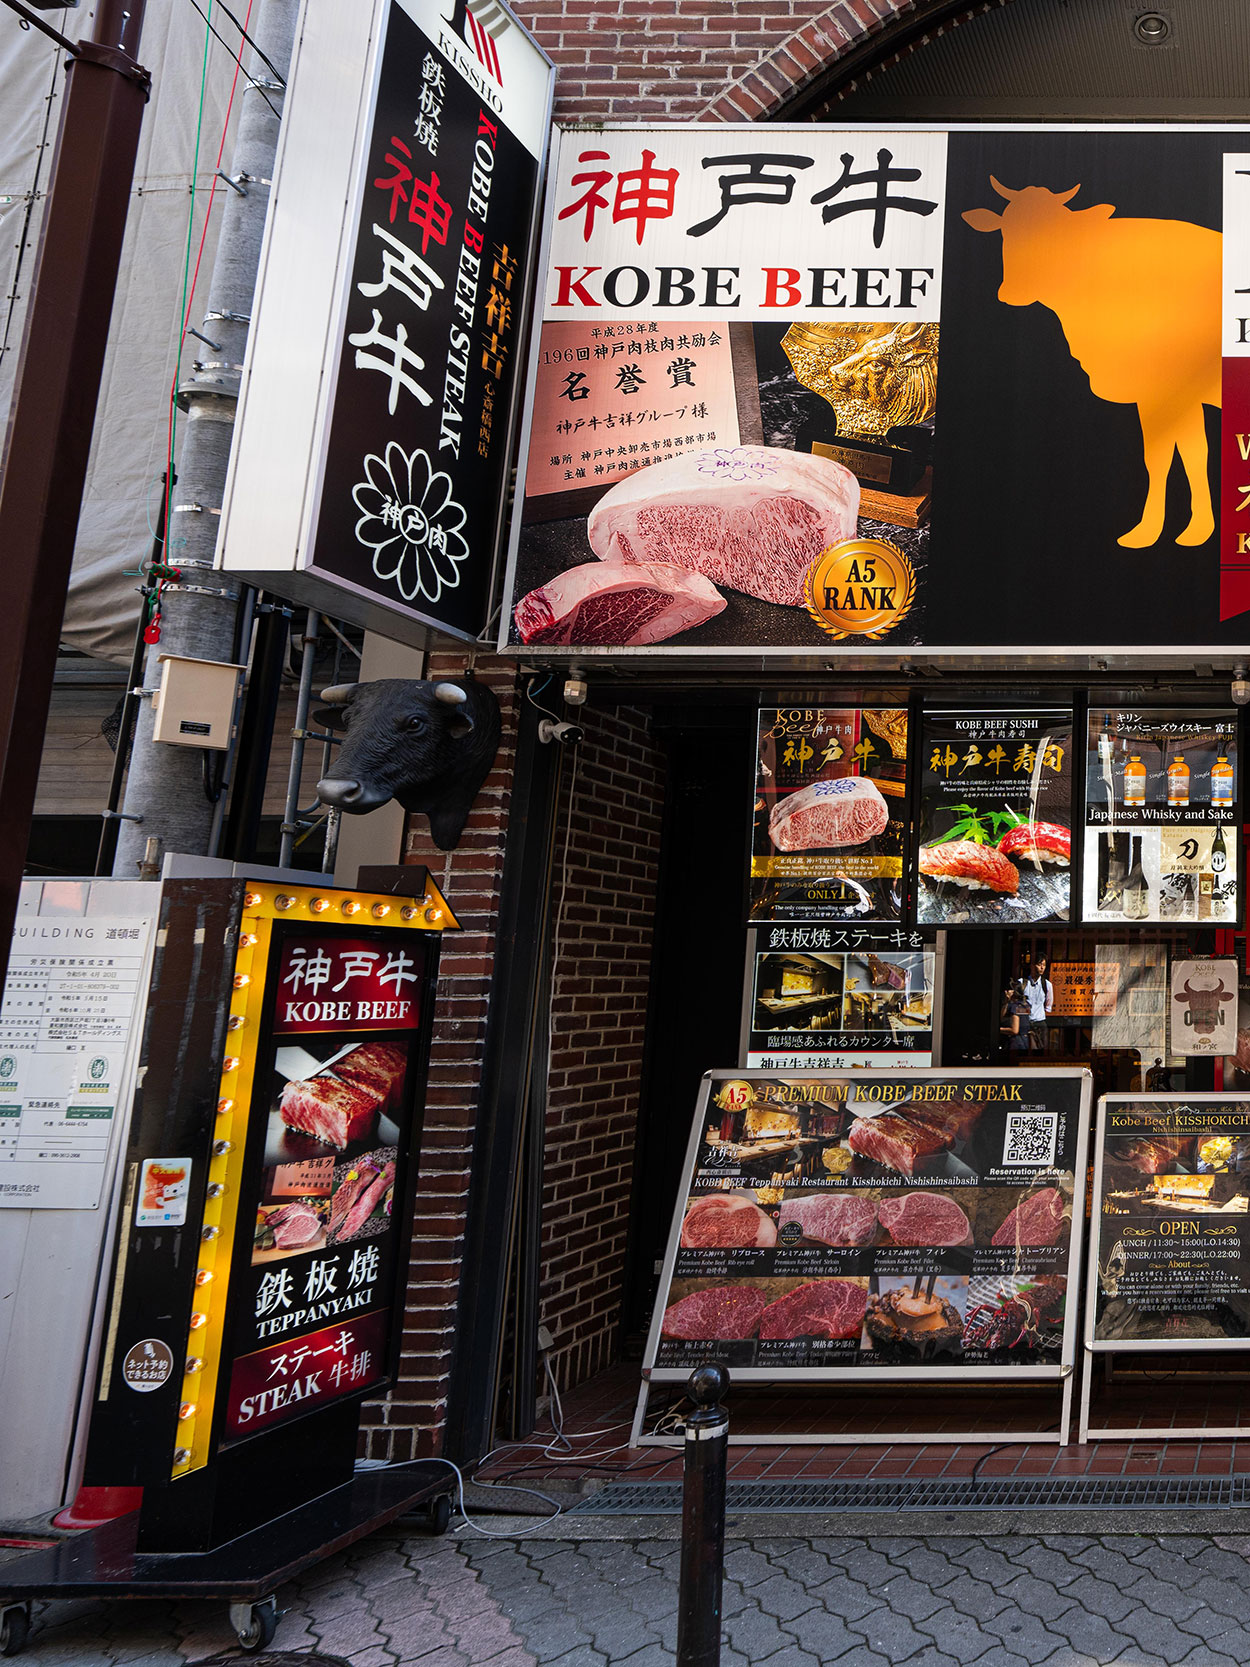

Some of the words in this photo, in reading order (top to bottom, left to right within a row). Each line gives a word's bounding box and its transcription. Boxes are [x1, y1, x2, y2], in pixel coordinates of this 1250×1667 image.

[437, 29, 504, 113] KISSHO
[413, 52, 446, 157] 鉄板焼
[467, 109, 499, 223] KOBE
[558, 149, 938, 248] 神戸牛
[348, 135, 454, 415] 神戸牛
[455, 222, 487, 327] BEEF
[551, 266, 741, 308] KOBE
[759, 267, 933, 308] BEEF
[481, 243, 519, 381] 吉祥吉
[591, 322, 659, 338] 平成28年度
[538, 331, 722, 364] 196回神戸肉枝肉共励会
[438, 329, 473, 459] STEAK
[477, 381, 495, 459] 心斎橋西店
[556, 405, 688, 435] 神戸牛吉祥グループ
[692, 402, 709, 418] 様
[550, 454, 572, 466] 場所
[380, 495, 449, 556] 神戸肉
[845, 560, 876, 583] A5
[823, 587, 897, 612] RANK
[777, 709, 824, 722] KOBE
[956, 720, 981, 729] KOBE
[984, 720, 1007, 729] BEEF
[1009, 720, 1038, 729] SUSHI
[1116, 713, 1143, 722] キリン
[763, 717, 826, 739] Beef
[1116, 723, 1212, 733] ジャパニーズウイスキー
[1215, 723, 1235, 733] 富士
[782, 737, 880, 773] 神戸牛
[929, 744, 1064, 778] 神戸牛寿司
[1089, 809, 1139, 821] Japanese
[1141, 809, 1182, 821] Whisky
[1184, 809, 1205, 820] and
[1208, 809, 1234, 820] Sake
[808, 890, 838, 900] ONLY
[769, 928, 923, 948] 鉄板焼ステーキを
[283, 947, 418, 998] 神戸牛
[283, 1002, 351, 1023] KOBE
[355, 1001, 411, 1022] BEEF
[767, 1036, 915, 1048] 臨場感あふれるカウンター席
[725, 1087, 748, 1104] A5
[764, 1085, 849, 1102] PREMIUM
[855, 1085, 906, 1102] KOBE
[911, 1085, 958, 1102] BEEF
[963, 1085, 1023, 1101] STEAK
[1112, 1116, 1141, 1126] Kobe
[1144, 1116, 1171, 1126] Beef
[749, 1177, 799, 1188] Teppanyaki
[801, 1176, 849, 1187] Restaurant
[852, 1176, 901, 1186] Kisshokichi
[904, 1176, 979, 1186] Nishishinsaibashi
[1160, 1222, 1200, 1235] OPEN
[827, 1249, 861, 1257] サーロイン
[1168, 1260, 1191, 1268] About
[256, 1245, 380, 1320] 鉄板焼
[256, 1289, 372, 1340] TEPPANYAKI
[128, 1359, 168, 1370] ネット予約
[270, 1331, 356, 1380] ステーキ
[127, 1370, 167, 1380] できるお店
[237, 1377, 321, 1426] STEAK
[329, 1351, 372, 1390] 牛排
